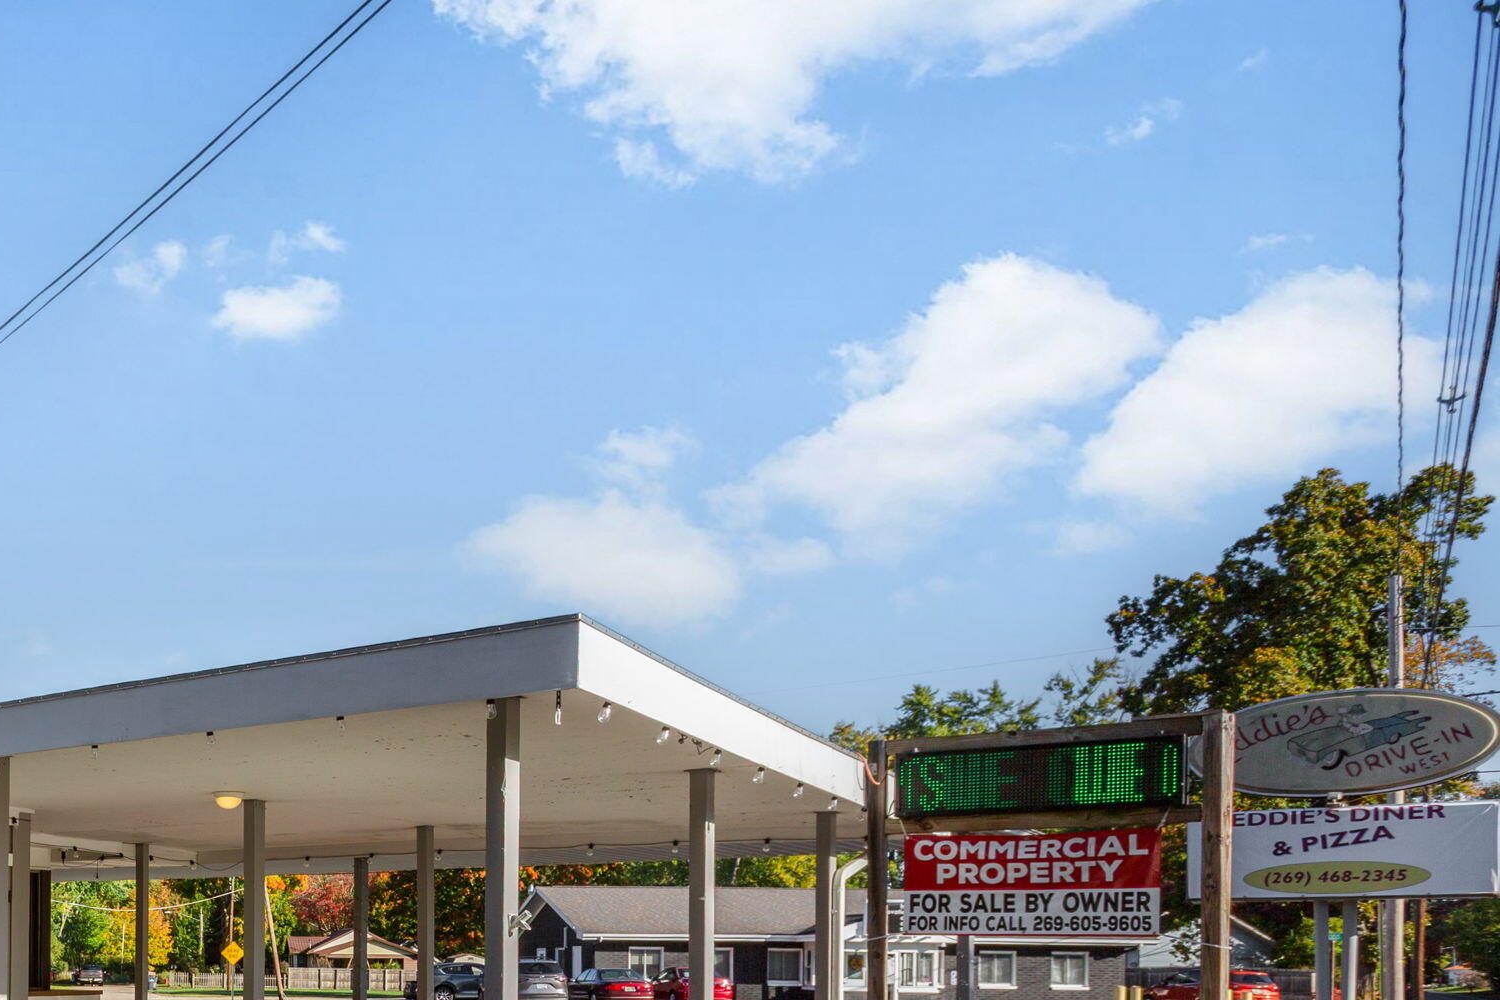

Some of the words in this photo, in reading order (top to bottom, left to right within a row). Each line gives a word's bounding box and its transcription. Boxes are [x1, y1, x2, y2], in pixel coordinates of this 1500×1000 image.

[1234, 705, 1333, 763] ddie's
[1345, 722, 1473, 777] DRIVE-IN
[1232, 807, 1340, 827] EDDIE'S
[1350, 804, 1446, 822] DINER
[913, 834, 1149, 861] COMMERCIAL
[1272, 841, 1292, 856] &
[1302, 825, 1395, 852] PIZZA
[936, 860, 1124, 885] PROPERTY
[1264, 871, 1311, 887] (269)
[1318, 868, 1408, 882] 468-2345
[909, 893, 951, 913] FOR
[959, 892, 1015, 913] SALE
[1025, 892, 1054, 913] BY
[1062, 892, 1151, 913] OWNER
[908, 916, 938, 931] FOR
[943, 916, 980, 931] INFO
[1033, 915, 1152, 931] 269-605-9605
